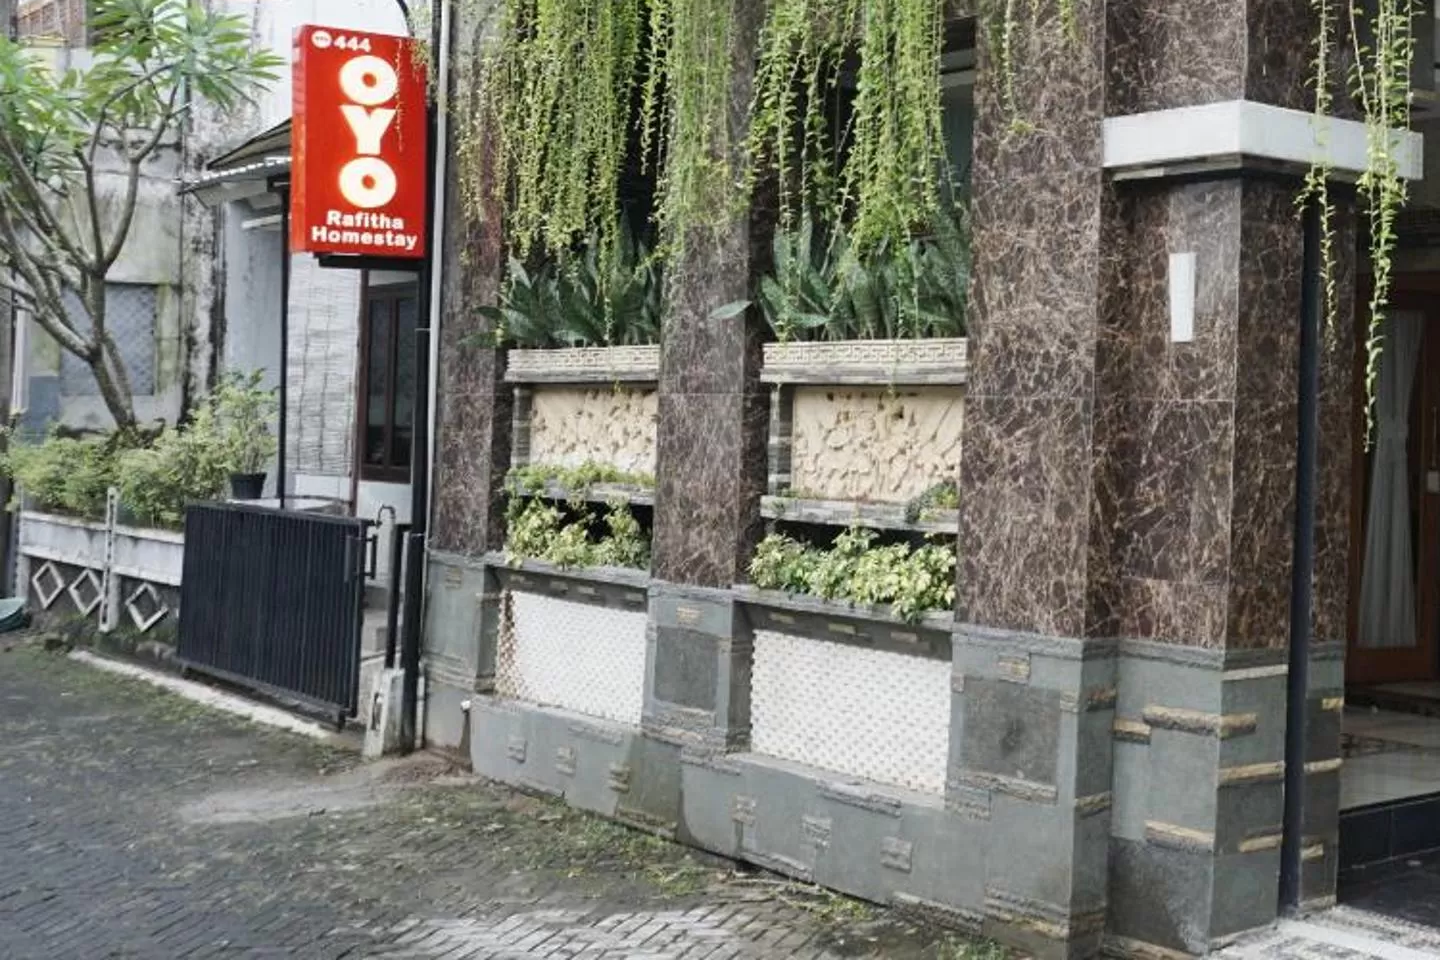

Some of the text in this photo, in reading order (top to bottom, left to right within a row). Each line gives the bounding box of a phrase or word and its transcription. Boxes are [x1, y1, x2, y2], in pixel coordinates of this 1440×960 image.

[334, 35, 372, 52] 444
[339, 54, 398, 208] OYO
[326, 210, 404, 230] Rafitha
[311, 226, 417, 250] Homestay
